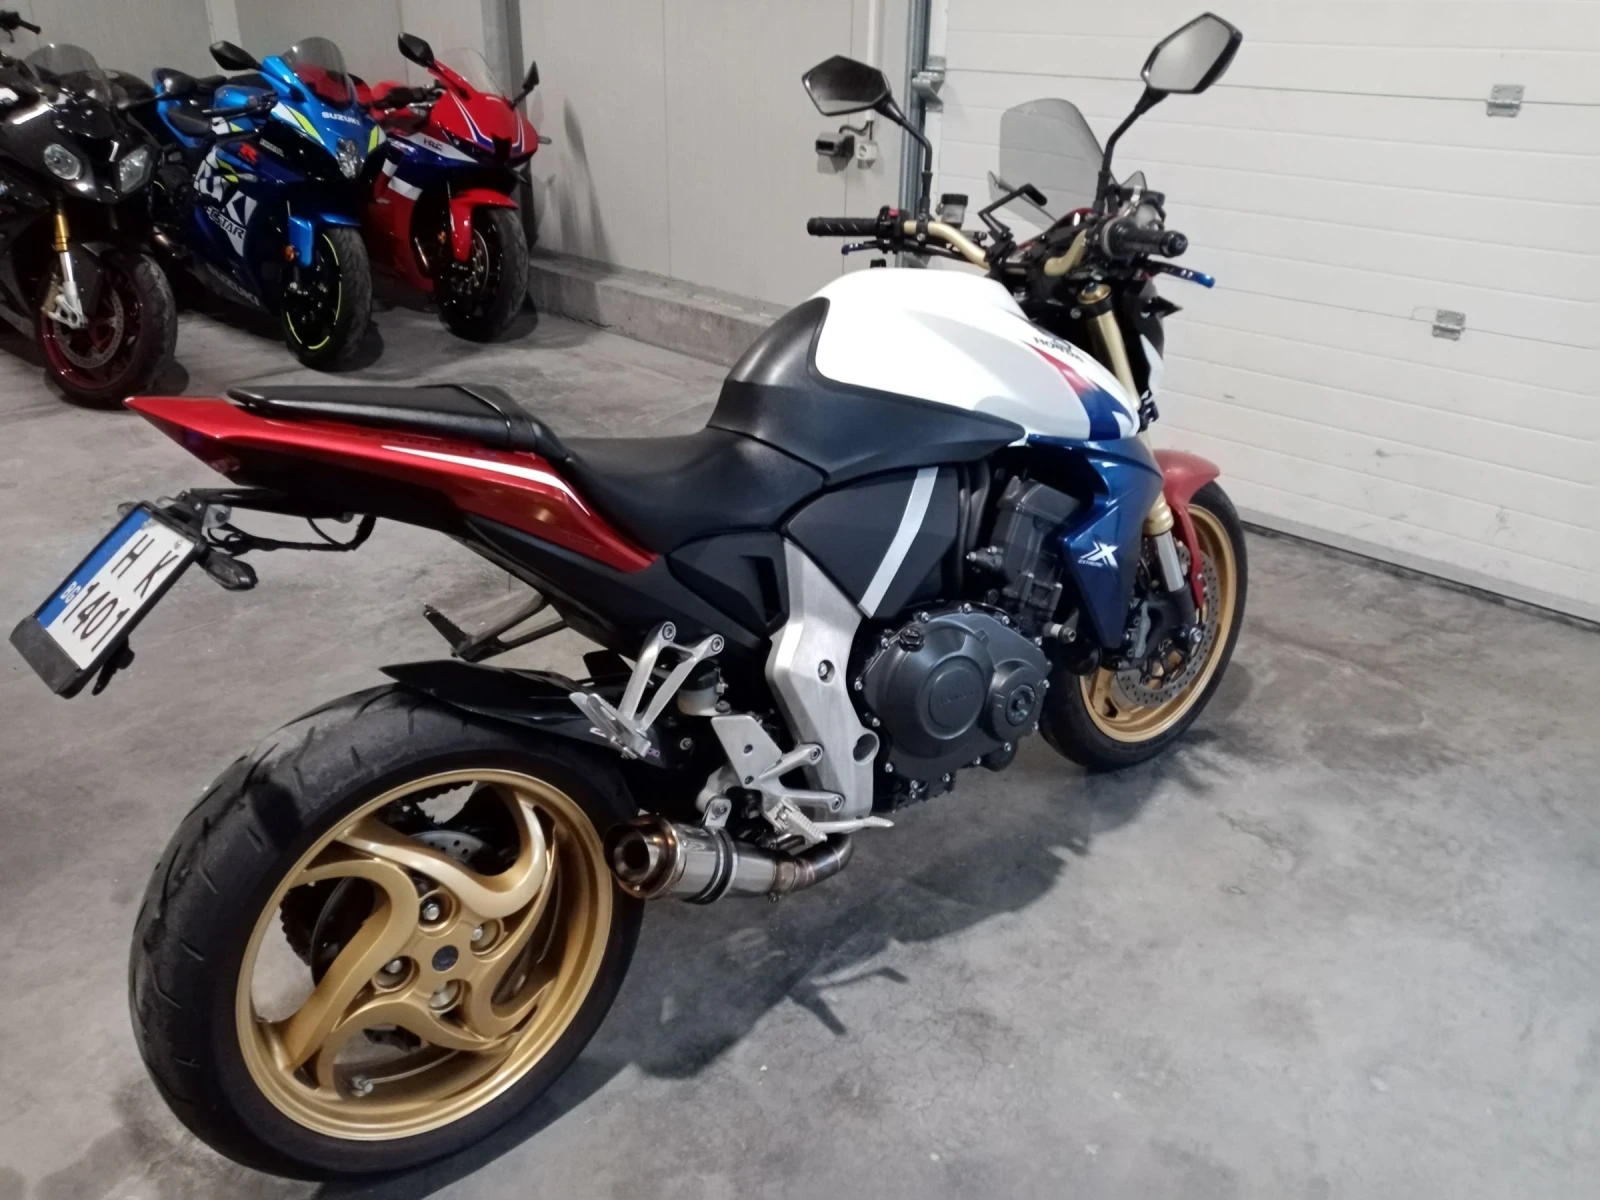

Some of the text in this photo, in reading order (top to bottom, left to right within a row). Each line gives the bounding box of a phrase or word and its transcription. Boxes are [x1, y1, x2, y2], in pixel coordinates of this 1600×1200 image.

[321, 111, 361, 126] SUZUKI
[423, 137, 443, 152] HRC
[111, 533, 179, 599] H K
[60, 581, 81, 604] BG
[62, 581, 131, 653] 1401
